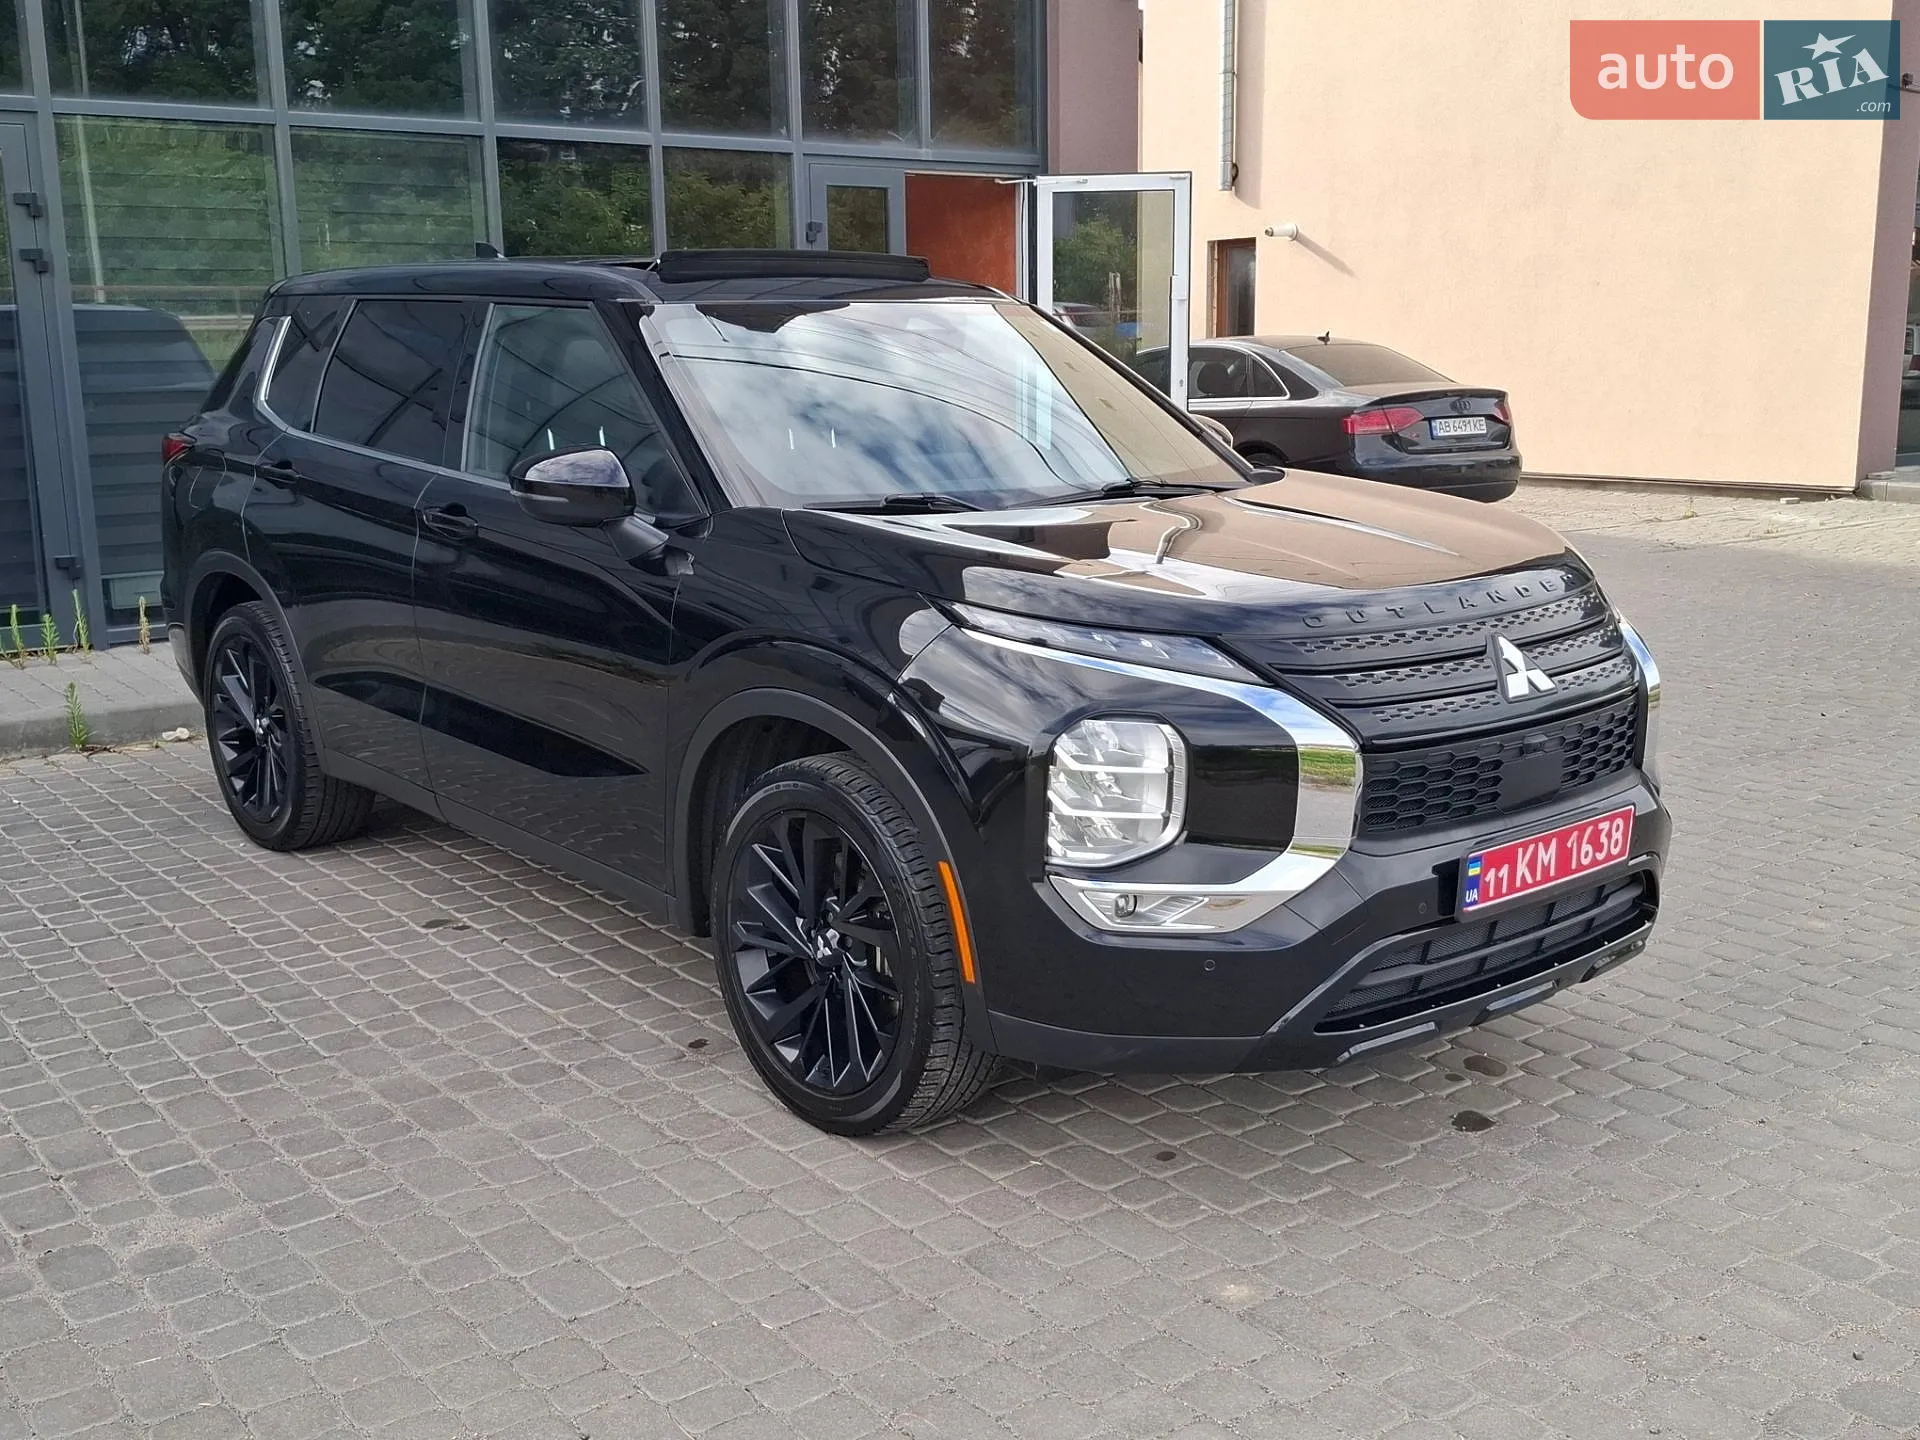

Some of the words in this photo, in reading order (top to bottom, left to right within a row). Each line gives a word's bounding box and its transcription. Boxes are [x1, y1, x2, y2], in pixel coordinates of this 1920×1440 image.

[1438, 420, 1451, 433] AB
[1452, 419, 1472, 432] 6491
[1472, 418, 1486, 431] KE
[1302, 573, 1576, 629] OUTLANDER
[1484, 863, 1510, 898] 11
[1515, 837, 1557, 888] KM
[1566, 817, 1625, 870] 1638
[1465, 889, 1479, 904] UA
